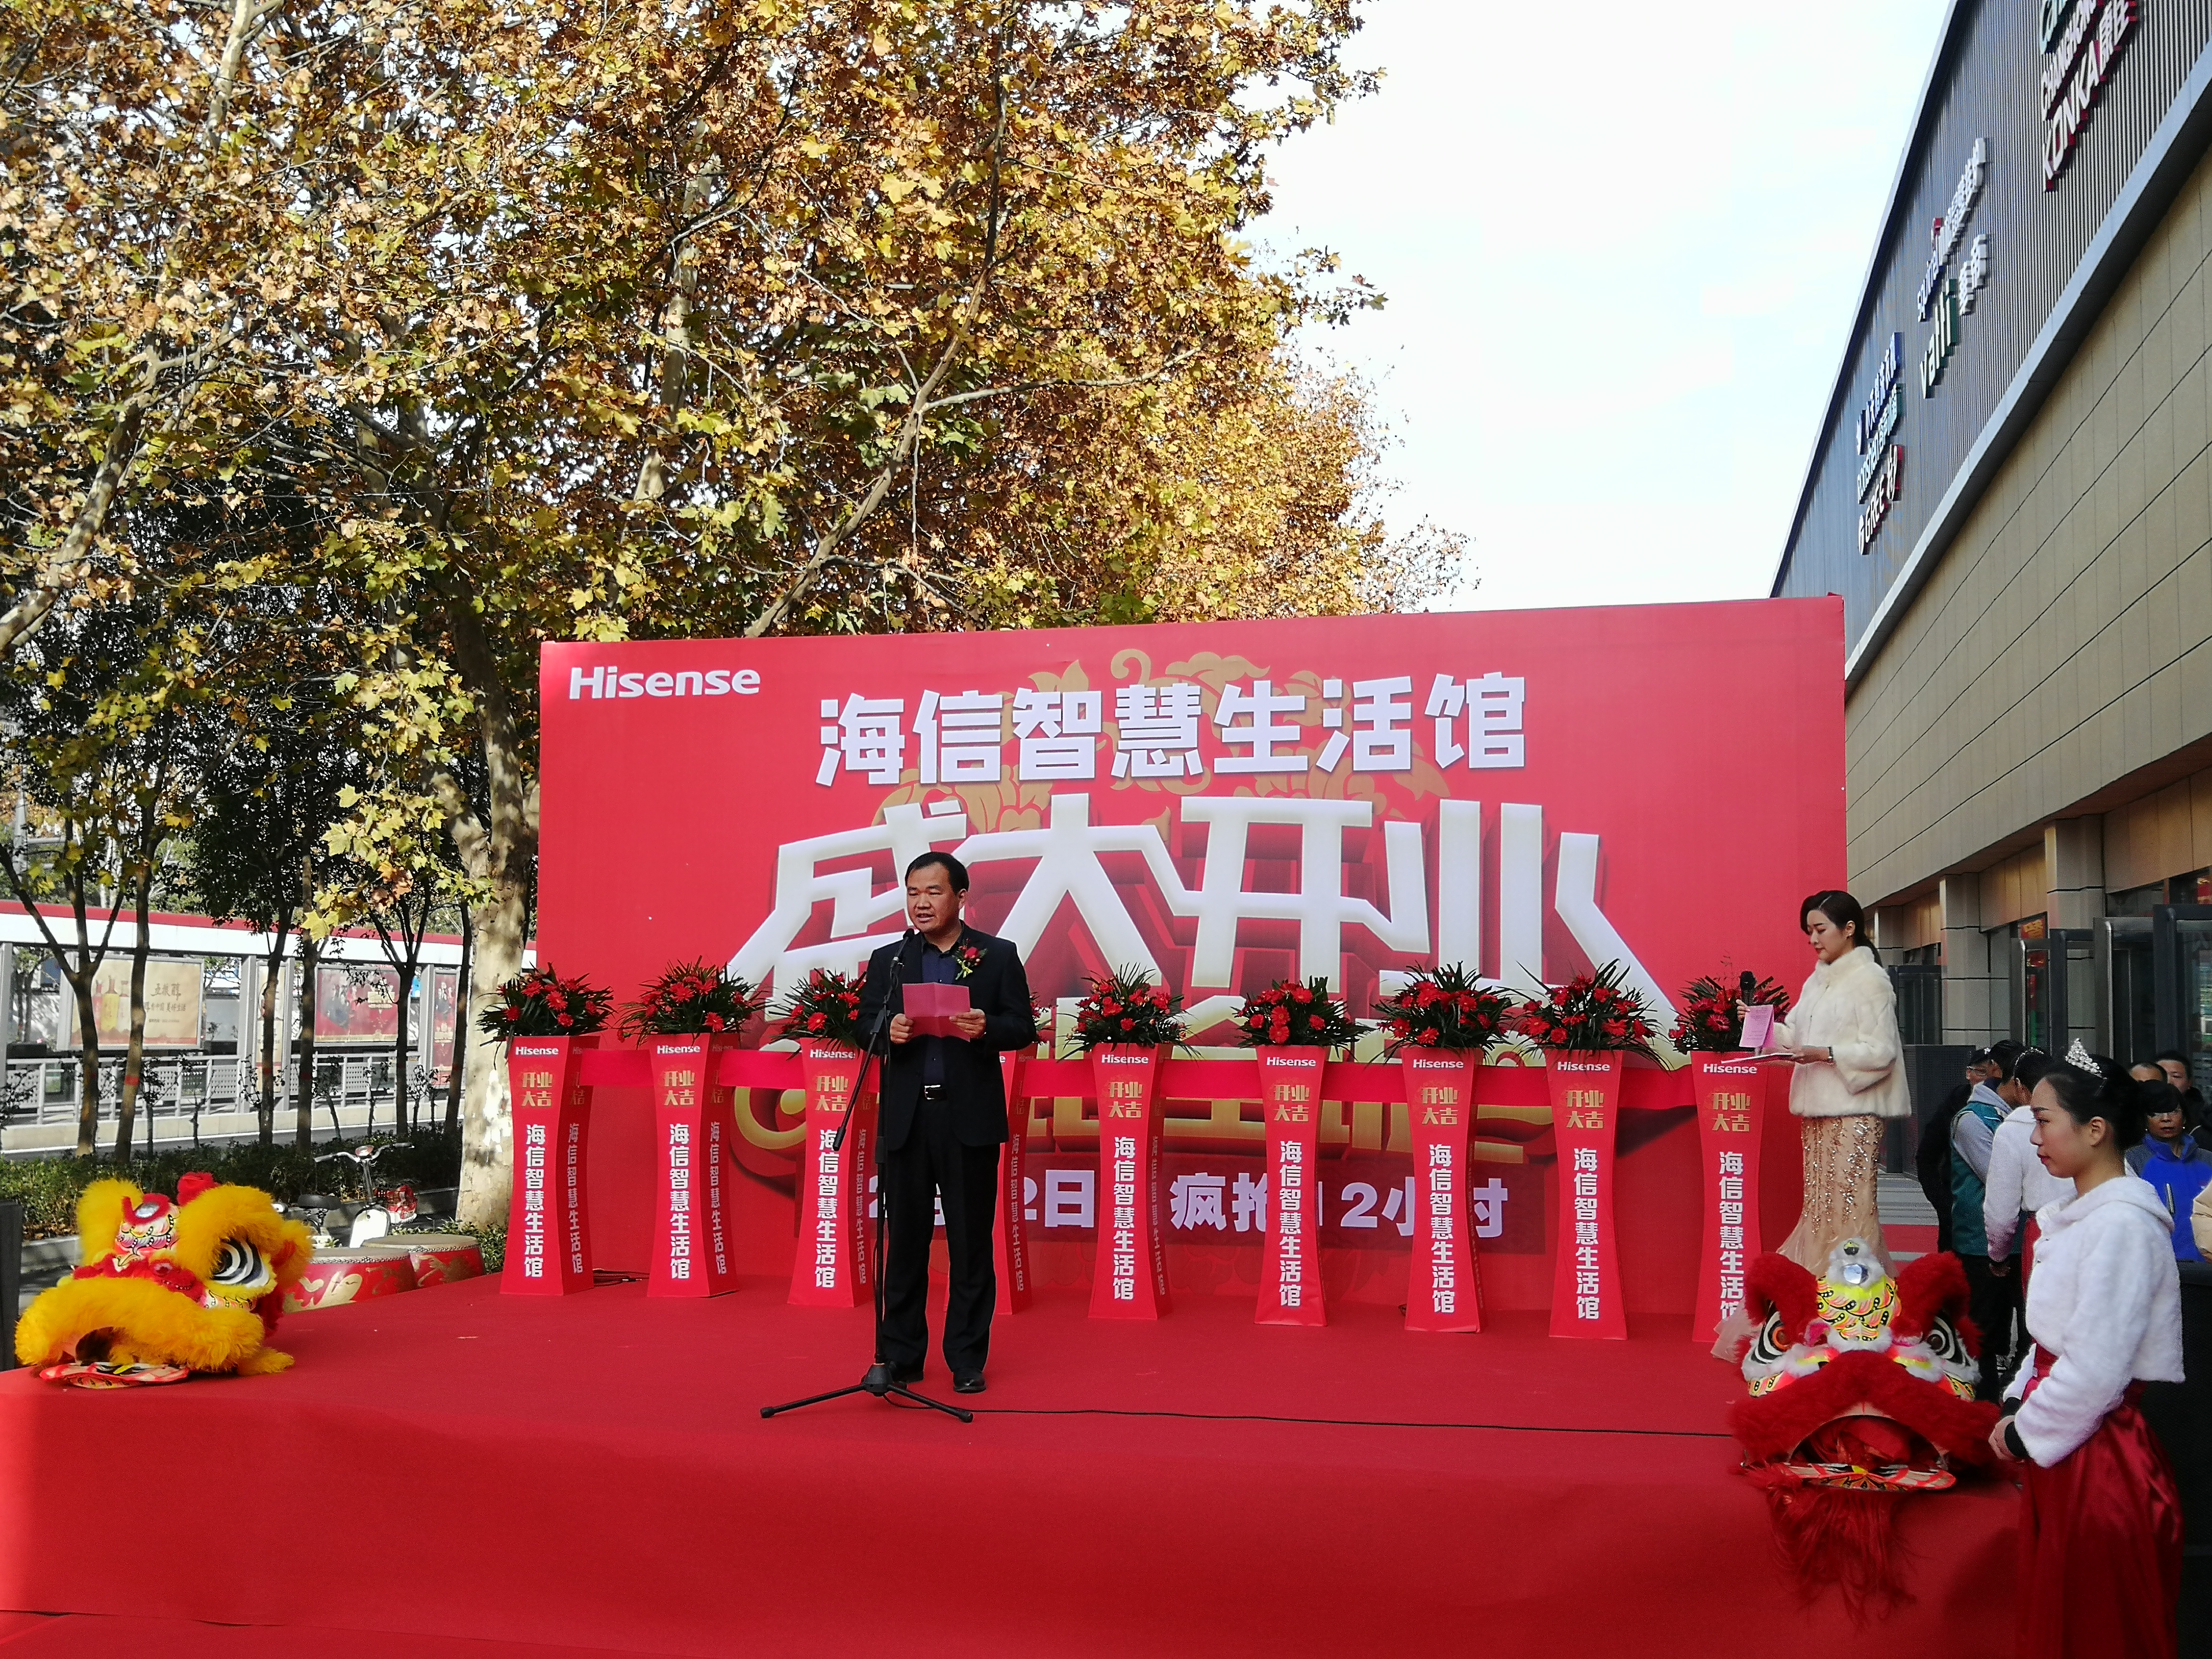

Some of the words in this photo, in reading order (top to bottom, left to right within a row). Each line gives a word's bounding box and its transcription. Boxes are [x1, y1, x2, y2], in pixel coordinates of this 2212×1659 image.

[1920, 279, 1951, 399] vatti
[1865, 473, 1885, 543] GREE
[569, 666, 760, 699] Hisense
[816, 672, 1526, 786] 海信智慧生活馆
[516, 1046, 559, 1056] Hisense
[657, 1045, 701, 1054] Hisense
[810, 1049, 855, 1059] Hisense
[1101, 1054, 1149, 1064] Hisense
[1266, 1057, 1316, 1067] Hisense
[1413, 1059, 1464, 1069] Hisense
[1557, 1061, 1611, 1071] Hisense
[1703, 1063, 1757, 1074] Hisense
[522, 1071, 553, 1088] 开业
[664, 1070, 695, 1087] 开业
[816, 1076, 849, 1093] 开业
[521, 1091, 553, 1107] 大吉
[663, 1089, 695, 1106] 大吉
[1108, 1082, 1143, 1099] 开业
[1274, 1084, 1310, 1102] 开业
[1421, 1087, 1458, 1104] 开业
[1565, 1090, 1604, 1107] 开业
[815, 1094, 848, 1112] 大吉
[1107, 1101, 1142, 1118] 大吉
[1711, 1093, 1751, 1111] 开业
[1274, 1104, 1310, 1122] 大吉
[1421, 1107, 1458, 1125] 大吉
[1565, 1110, 1604, 1129] 大吉
[1711, 1113, 1751, 1132] 大吉
[524, 1124, 546, 1277] 海信智慧生活馆
[567, 1122, 583, 1274] 海信智慧生活馆
[669, 1123, 690, 1279] 海信智慧生活馆
[709, 1121, 727, 1275] 海信智慧生活馆
[815, 1129, 840, 1288] 海信智慧生活馆
[1010, 1133, 1024, 1292] 海信智慧生活馆
[1113, 1136, 1135, 1300] 海信智慧生活馆
[1279, 1141, 1302, 1307] 海信智慧生活馆
[1429, 1144, 1455, 1313] 海信智慧生活馆
[1574, 1148, 1599, 1319] 海信智慧生活馆
